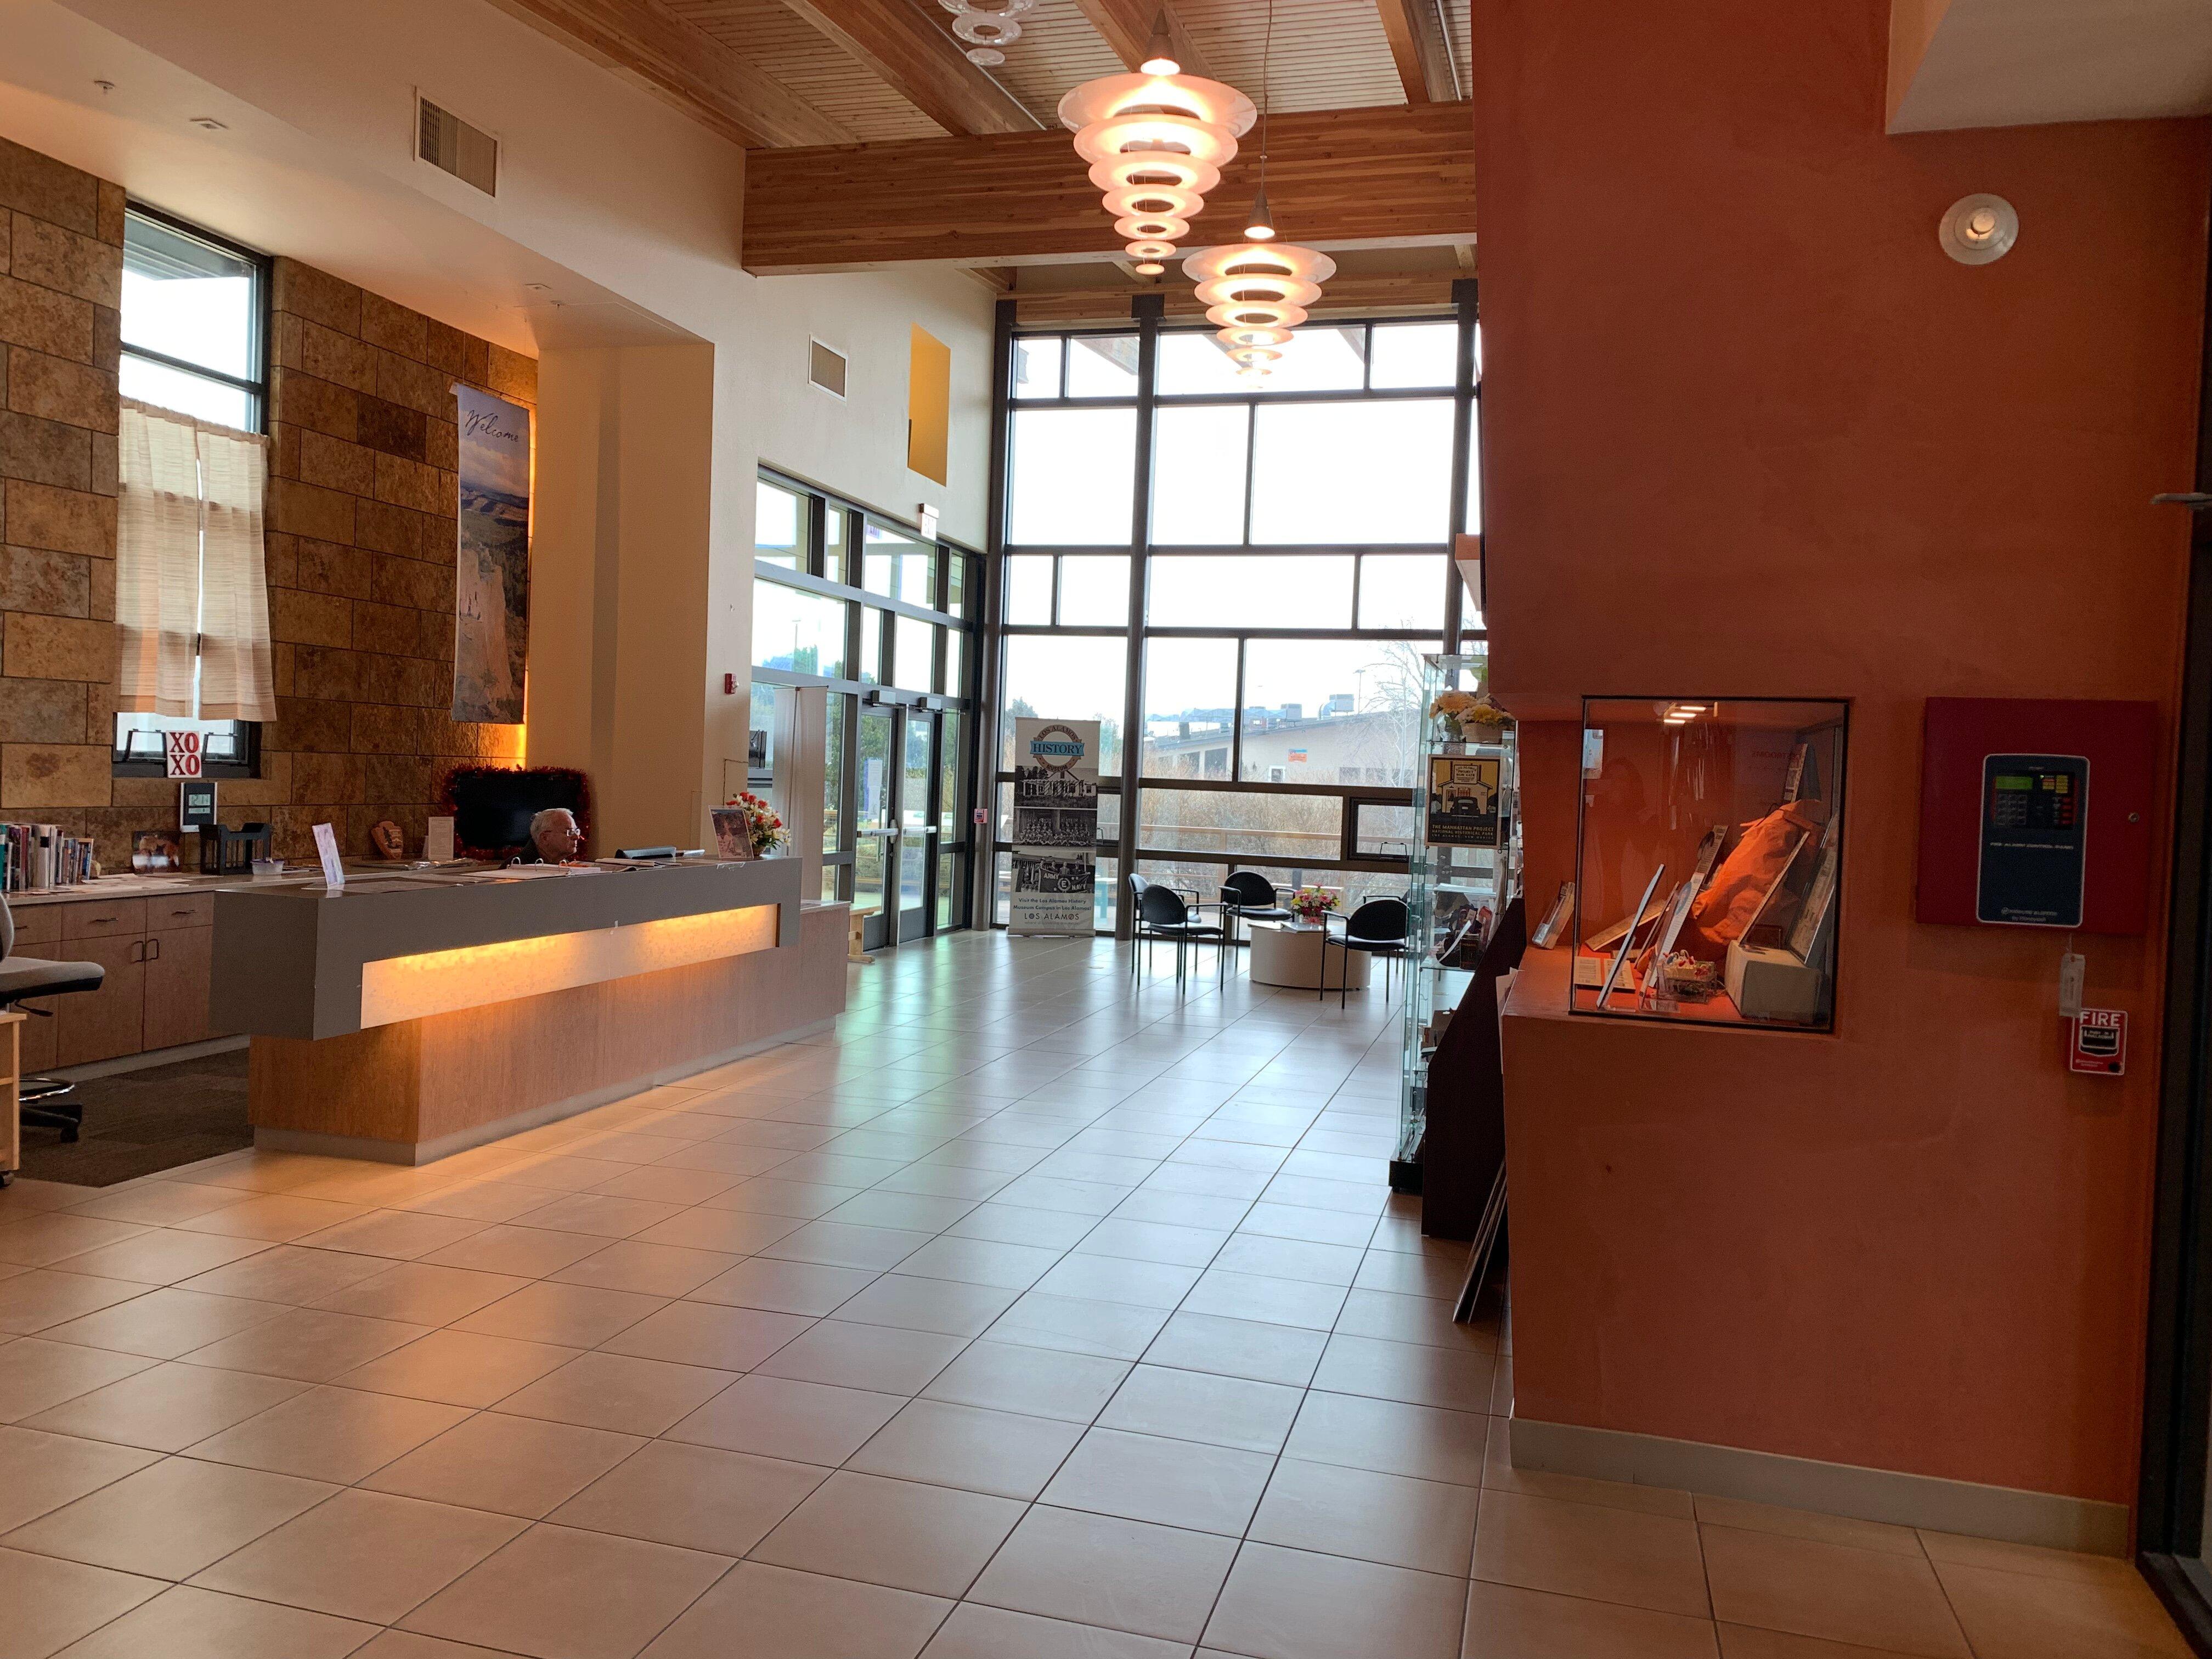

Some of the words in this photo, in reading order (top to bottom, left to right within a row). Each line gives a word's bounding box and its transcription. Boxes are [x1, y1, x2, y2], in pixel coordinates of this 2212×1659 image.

[465, 409, 519, 442] Welcome
[1038, 727, 1050, 740] LOS
[1052, 725, 1076, 740] ALAMOS
[169, 732, 199, 753] XO
[1033, 743, 1083, 754] HISTORY
[170, 754, 200, 775] XO
[2080, 1011, 2121, 1026] FIRE
